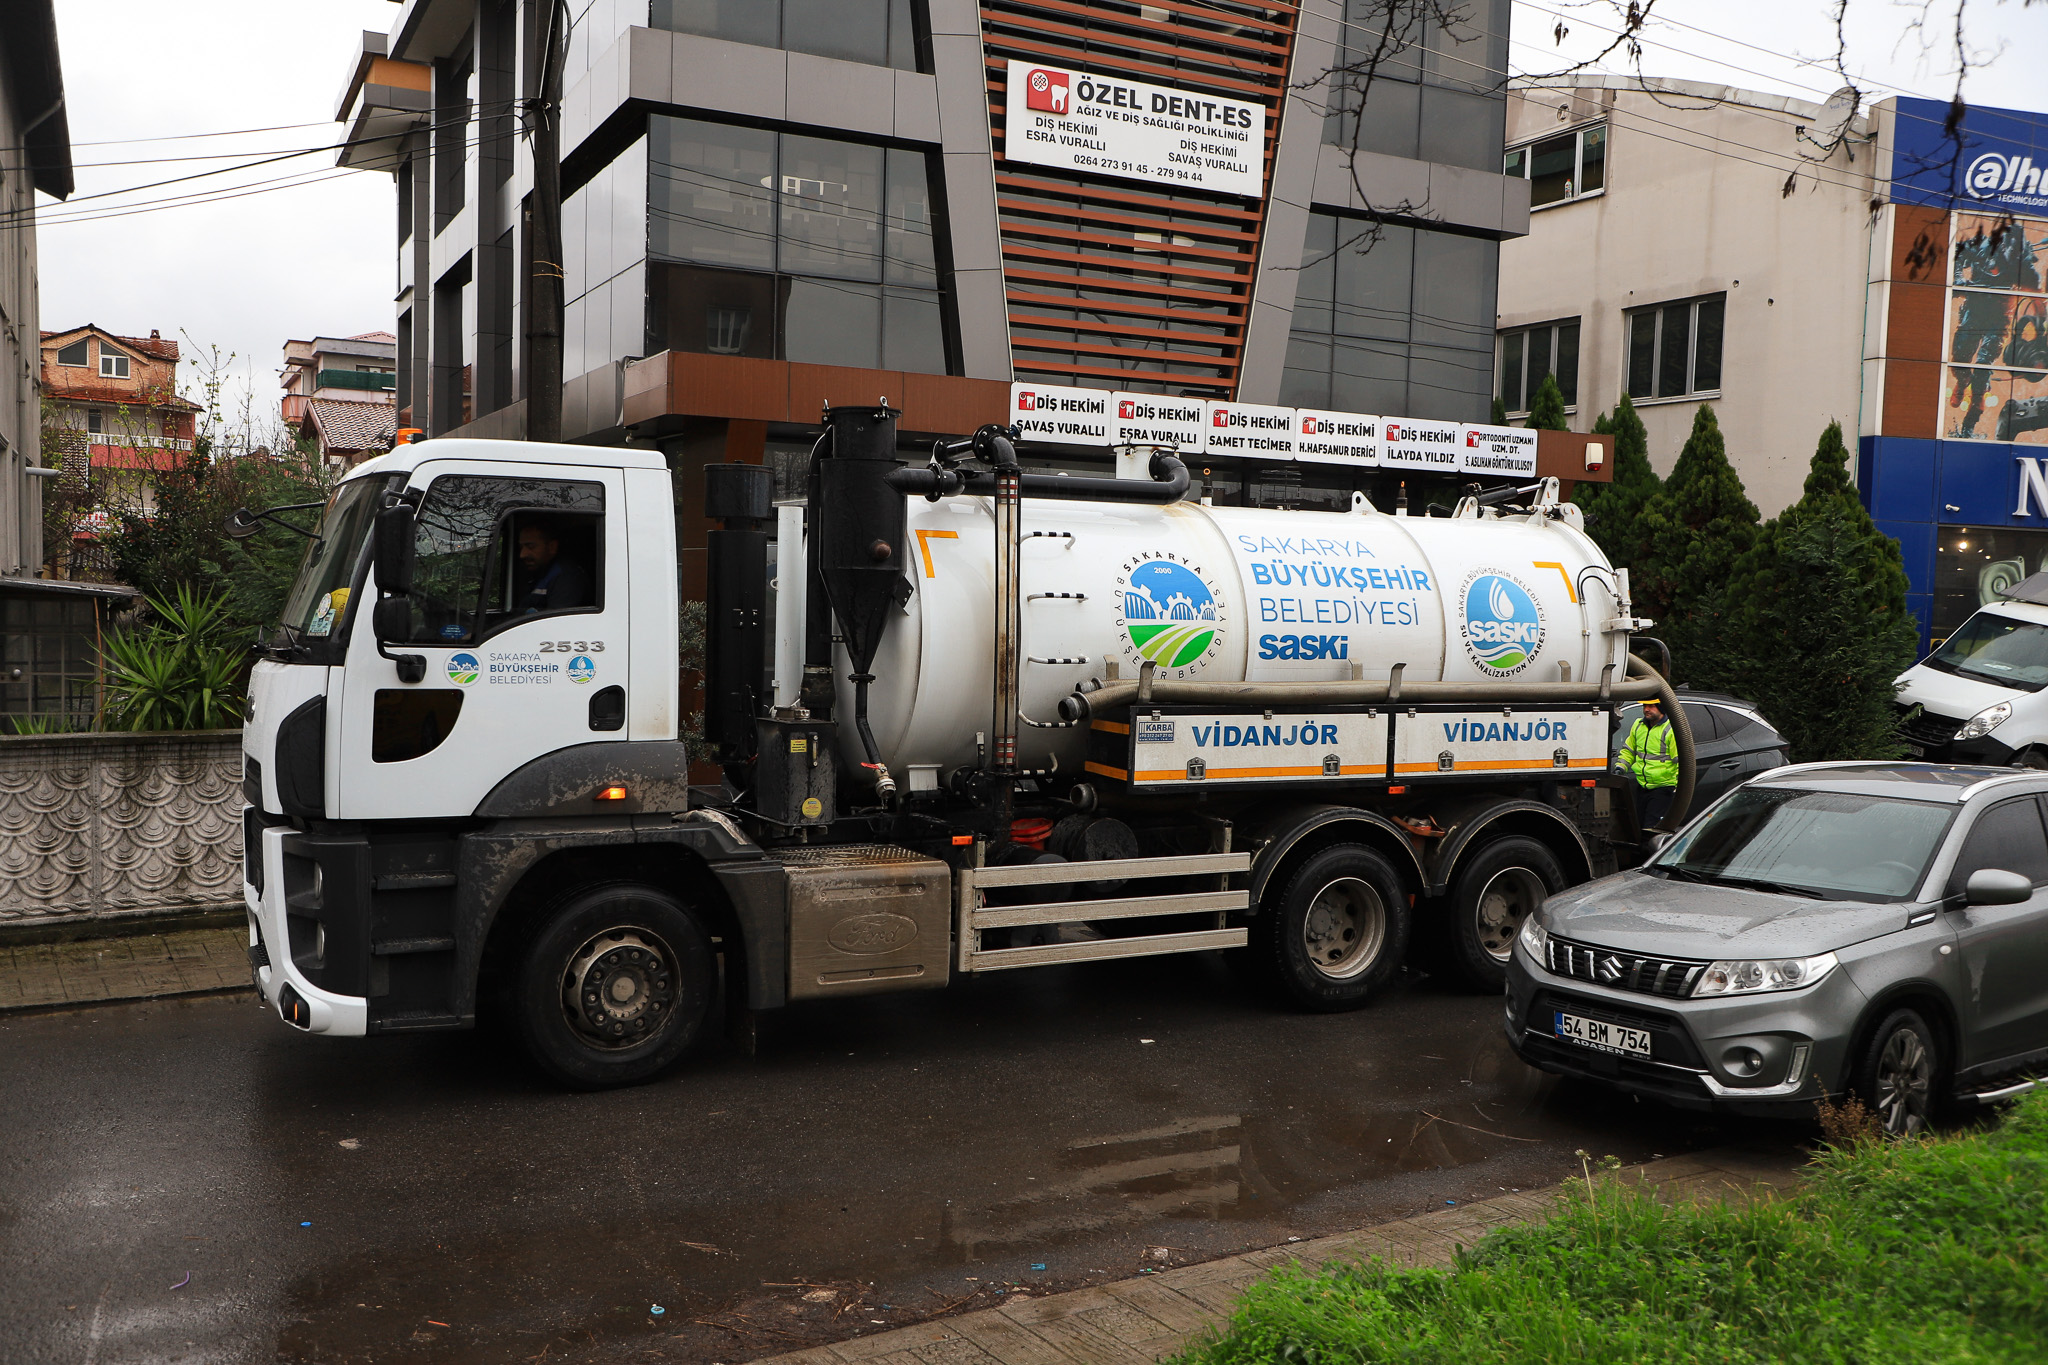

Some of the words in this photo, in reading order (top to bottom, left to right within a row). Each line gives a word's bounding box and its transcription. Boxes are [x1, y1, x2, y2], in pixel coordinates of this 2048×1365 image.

[1077, 75, 1142, 110] ÖZEL
[1151, 93, 1252, 128] DENT-ES
[1036, 116, 1055, 130] DİŞ
[1058, 120, 1098, 136] HEKİMİ
[1076, 104, 1102, 118] AĞIZ
[1106, 110, 1119, 120] VE
[1123, 111, 1140, 126] DİŞ
[1143, 115, 1184, 132] SAĞLIĞI
[1188, 124, 1248, 142] POLİKLİNİĞİ
[1026, 130, 1056, 143] ESRA
[1060, 134, 1106, 151] VURALLI
[1180, 138, 1197, 153] DİŞ
[1200, 143, 1237, 158] HEKİMİ
[1074, 154, 1098, 166] 0264
[1101, 158, 1118, 169] 273
[1121, 160, 1133, 171] 91
[1136, 162, 1148, 174] 45
[1157, 165, 1174, 178] 279
[1177, 168, 1189, 180] 94
[1191, 170, 1202, 182] 44
[1168, 152, 1202, 168] SAVAŞ
[1205, 157, 1248, 174] VURALLI
[1037, 396, 1057, 411] DİŞ
[1060, 398, 1104, 414] HEKİMİ
[1136, 404, 1155, 420] DİŞ
[1158, 407, 1200, 423] HEKİMİ
[1017, 420, 1054, 434] SAVAŞ
[1058, 422, 1105, 437] VURALLI
[1230, 412, 1247, 428] DİŞ
[1251, 416, 1289, 430] HEKİMİ
[1317, 420, 1335, 436] DİŞ
[1337, 423, 1375, 438] HEKİMİ
[1119, 428, 1149, 441] ESRA
[1151, 430, 1196, 444] VURALLI
[1209, 435, 1245, 448] SAMET
[1248, 437, 1291, 452] TECİMER
[1401, 426, 1417, 442] DİŞ
[1420, 430, 1455, 444] HEKİMİ
[1479, 433, 1511, 443] ORTODONTİ
[1512, 436, 1534, 445] UZMANI
[1299, 442, 1349, 457] H.HAFSANUR
[1350, 445, 1376, 458] DERİCİ
[1387, 446, 1422, 463] İLAYDA
[1424, 451, 1455, 464] YILDIZ
[1492, 445, 1508, 453] UZM.
[1509, 446, 1520, 454] DT.
[1471, 457, 1492, 468] ASLIHAN
[1492, 455, 1514, 470] GÖKTÜRK
[1238, 535, 1375, 558] SAKARYA
[1123, 551, 1201, 574] SAKARYA
[1251, 558, 1432, 593] BÜYÜKŞEHİR
[1459, 580, 1470, 618] SAKARYA
[1260, 595, 1419, 626] BELEDİYESİ
[1460, 625, 1467, 637] SU
[539, 641, 605, 653] 2533
[1465, 641, 1473, 654] VE
[490, 653, 540, 661] SAKARYA
[1471, 654, 1527, 678] KANALİZASYON
[490, 662, 559, 674] BÜYÜKŞEHİR
[490, 674, 552, 684] BELEDİYESİ
[1192, 721, 1338, 747] VİDANJÖR
[1443, 718, 1567, 742] VİDANJÖR
[844, 920, 900, 946] Ford
[1564, 1016, 1582, 1036] 54
[1589, 1022, 1608, 1043] BM
[1617, 1028, 1649, 1052] 754
[1572, 1038, 1625, 1055] ADASEN
